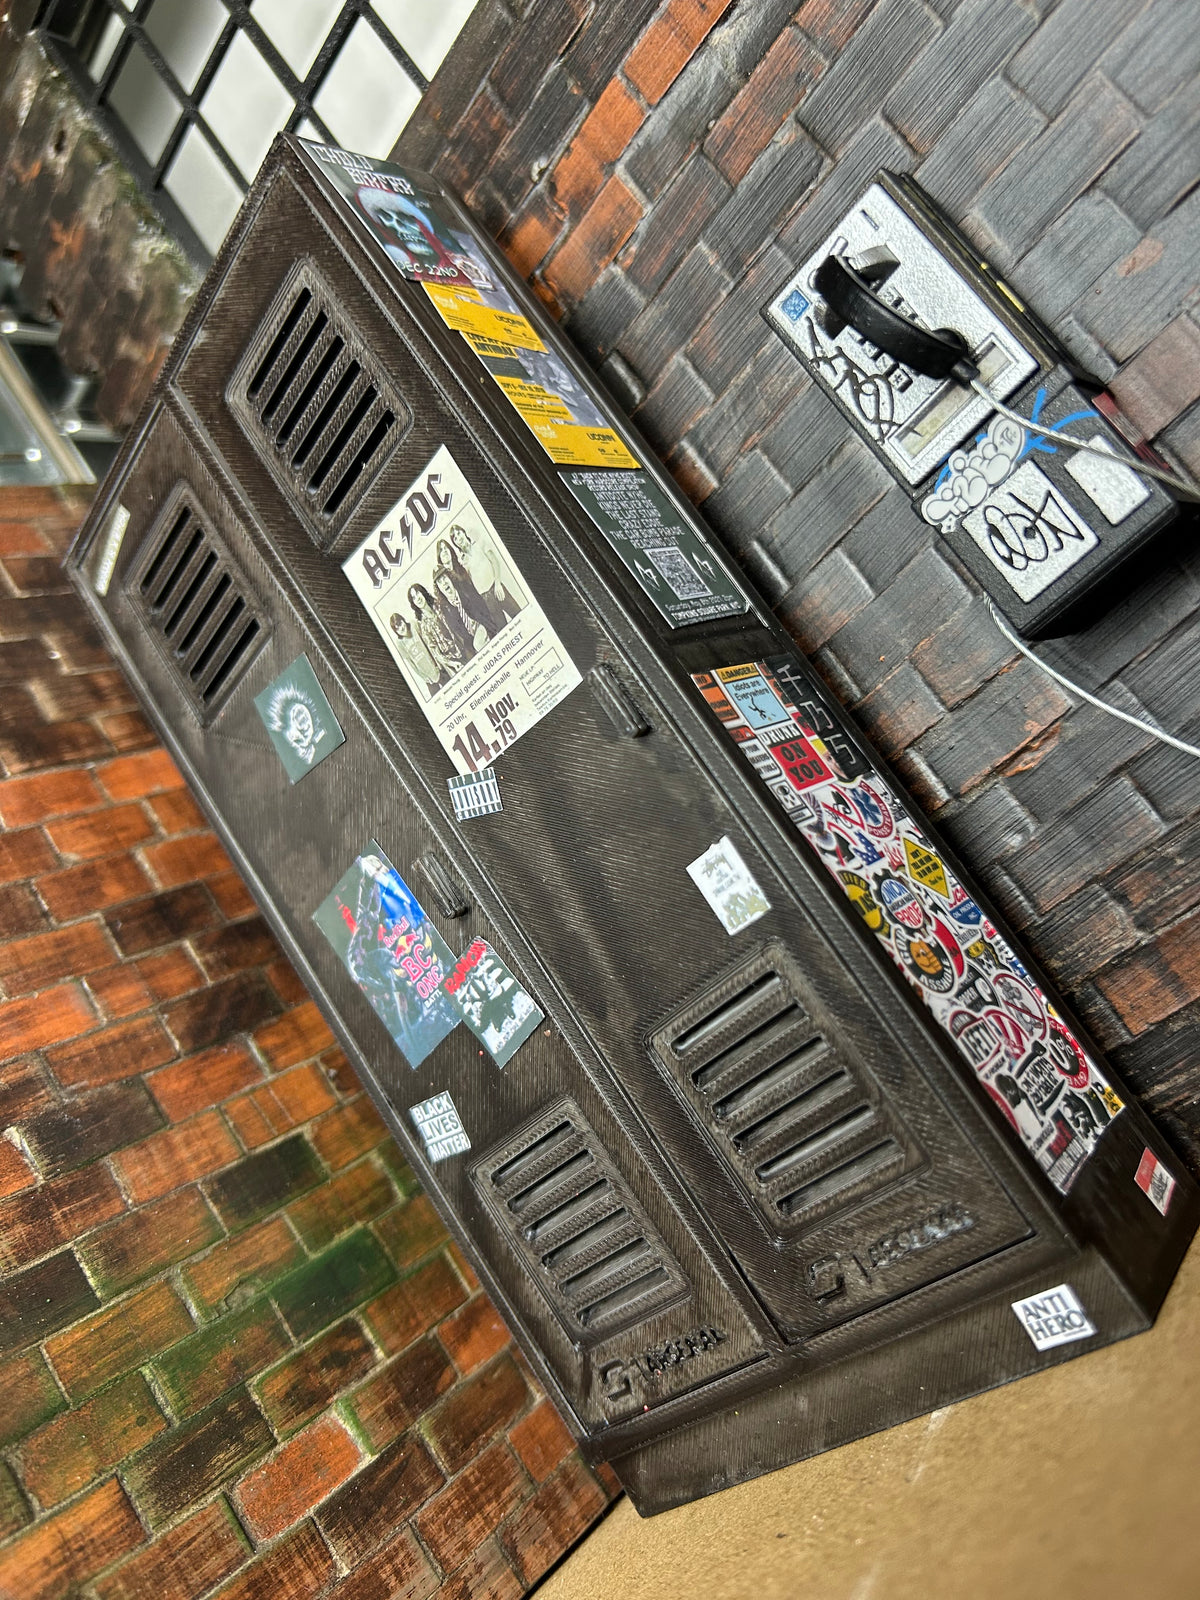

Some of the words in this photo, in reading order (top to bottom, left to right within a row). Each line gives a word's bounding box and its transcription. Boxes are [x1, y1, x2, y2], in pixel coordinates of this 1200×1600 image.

[585, 432, 617, 442] UCONN
[605, 510, 624, 520] THE
[619, 509, 641, 519] LAST
[608, 530, 628, 540] THE
[695, 605, 718, 615] SQUARE
[443, 688, 464, 710] Special
[462, 672, 481, 693] guest:
[481, 651, 503, 674] JUDAS
[500, 631, 524, 655] PRIEST
[446, 721, 455, 732] 20
[453, 710, 467, 726] Uhr,
[468, 669, 512, 711] Eilenriedehalle
[513, 638, 545, 669] Hannover
[731, 681, 751, 691] Idiots
[733, 686, 771, 701] Everywhere
[757, 724, 801, 745] DRUNK
[777, 741, 809, 763] ON
[787, 758, 826, 784] YOU
[881, 879, 909, 904] UNION
[895, 901, 923, 927] PRIDE
[401, 945, 432, 983] BC
[416, 965, 444, 998] ONE
[412, 1094, 453, 1126] BLACK
[421, 1113, 459, 1141] LIVES
[427, 1132, 469, 1163] MATTER
[1021, 1293, 1070, 1322] ANTI
[1028, 1309, 1085, 1342] HERO
